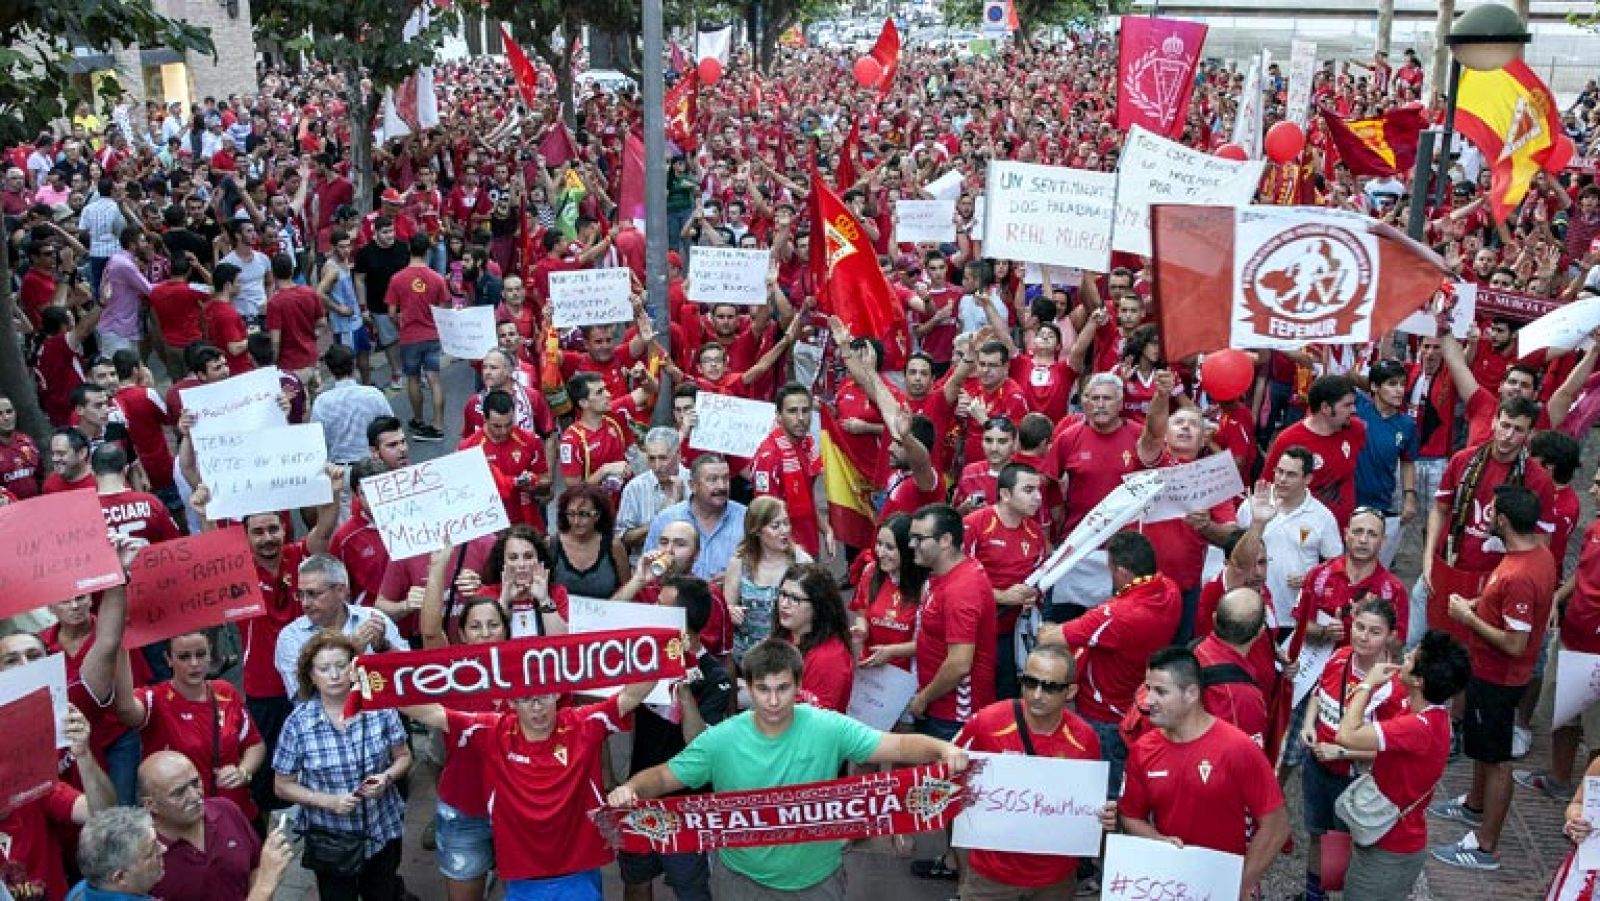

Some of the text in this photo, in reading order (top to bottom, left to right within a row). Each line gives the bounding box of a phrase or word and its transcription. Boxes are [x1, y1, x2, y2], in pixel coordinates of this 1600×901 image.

[1001, 172, 1023, 190] UN
[1010, 200, 1039, 213] DOS
[1006, 222, 1045, 244] REAL
[365, 462, 442, 501] TEBAS
[393, 634, 659, 697] real murcia
[684, 809, 769, 829] REAL
[777, 794, 901, 825] MURCIA
